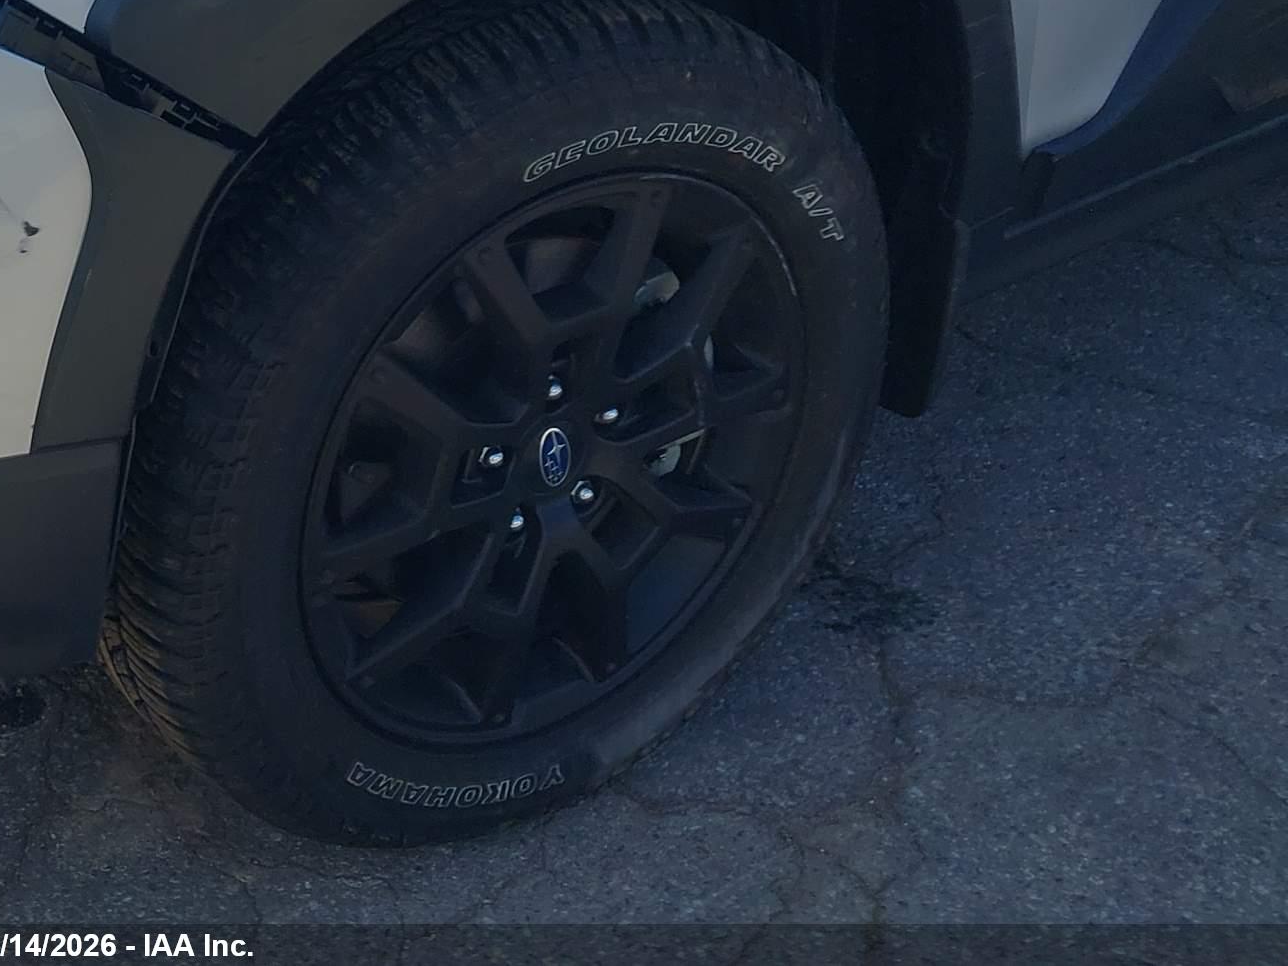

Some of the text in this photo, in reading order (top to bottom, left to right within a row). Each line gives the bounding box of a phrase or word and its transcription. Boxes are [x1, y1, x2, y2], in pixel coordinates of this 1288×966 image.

[522, 122, 845, 242] GEOLANDAR A/T
[346, 761, 566, 808] YOKOHAMA
